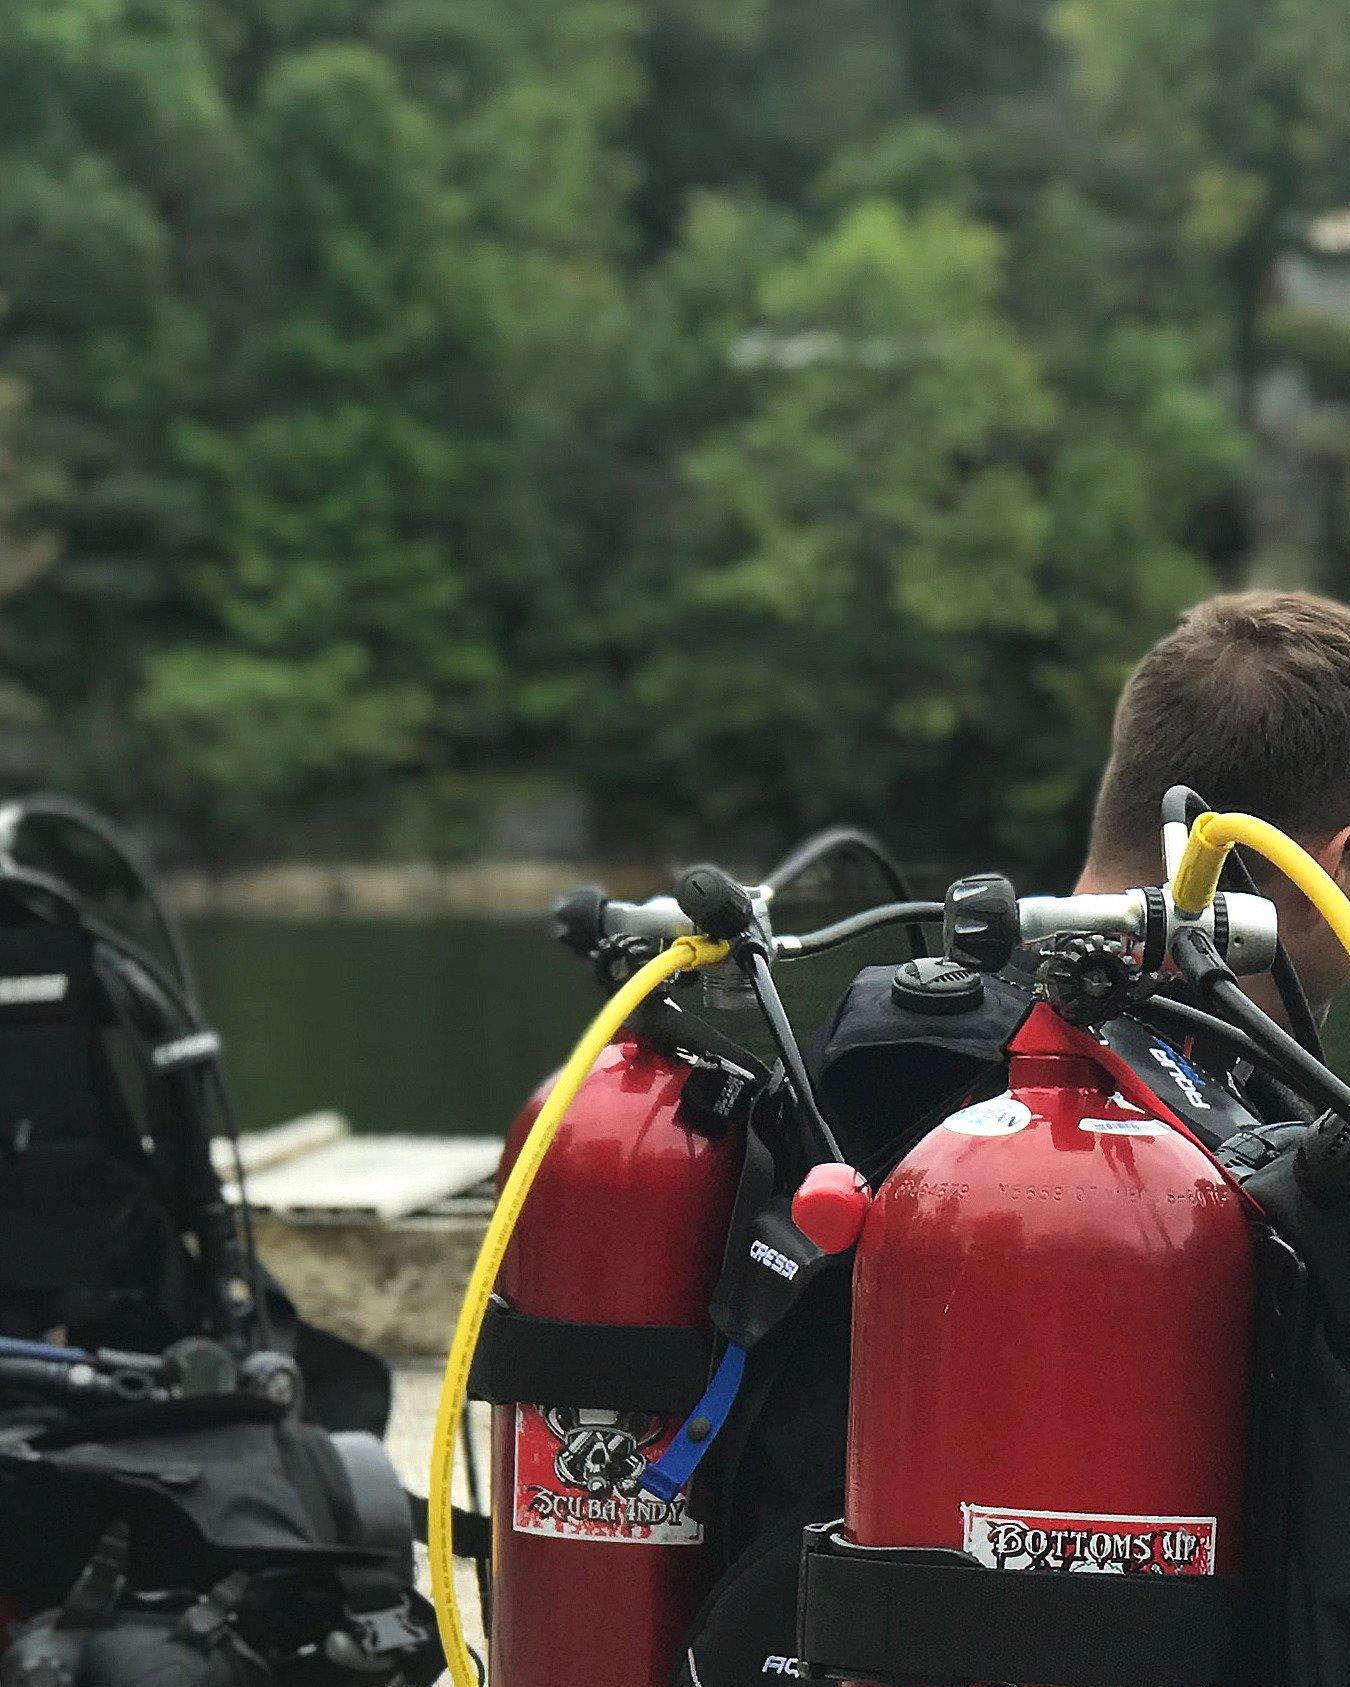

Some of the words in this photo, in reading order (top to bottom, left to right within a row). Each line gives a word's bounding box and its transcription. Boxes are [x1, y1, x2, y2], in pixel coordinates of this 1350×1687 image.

[750, 1240, 799, 1280] CRESSI
[529, 1485, 616, 1522] SCUBA
[626, 1496, 686, 1526] INDY
[988, 1520, 1152, 1562] BOTTOMS
[1162, 1529, 1199, 1562] UP
